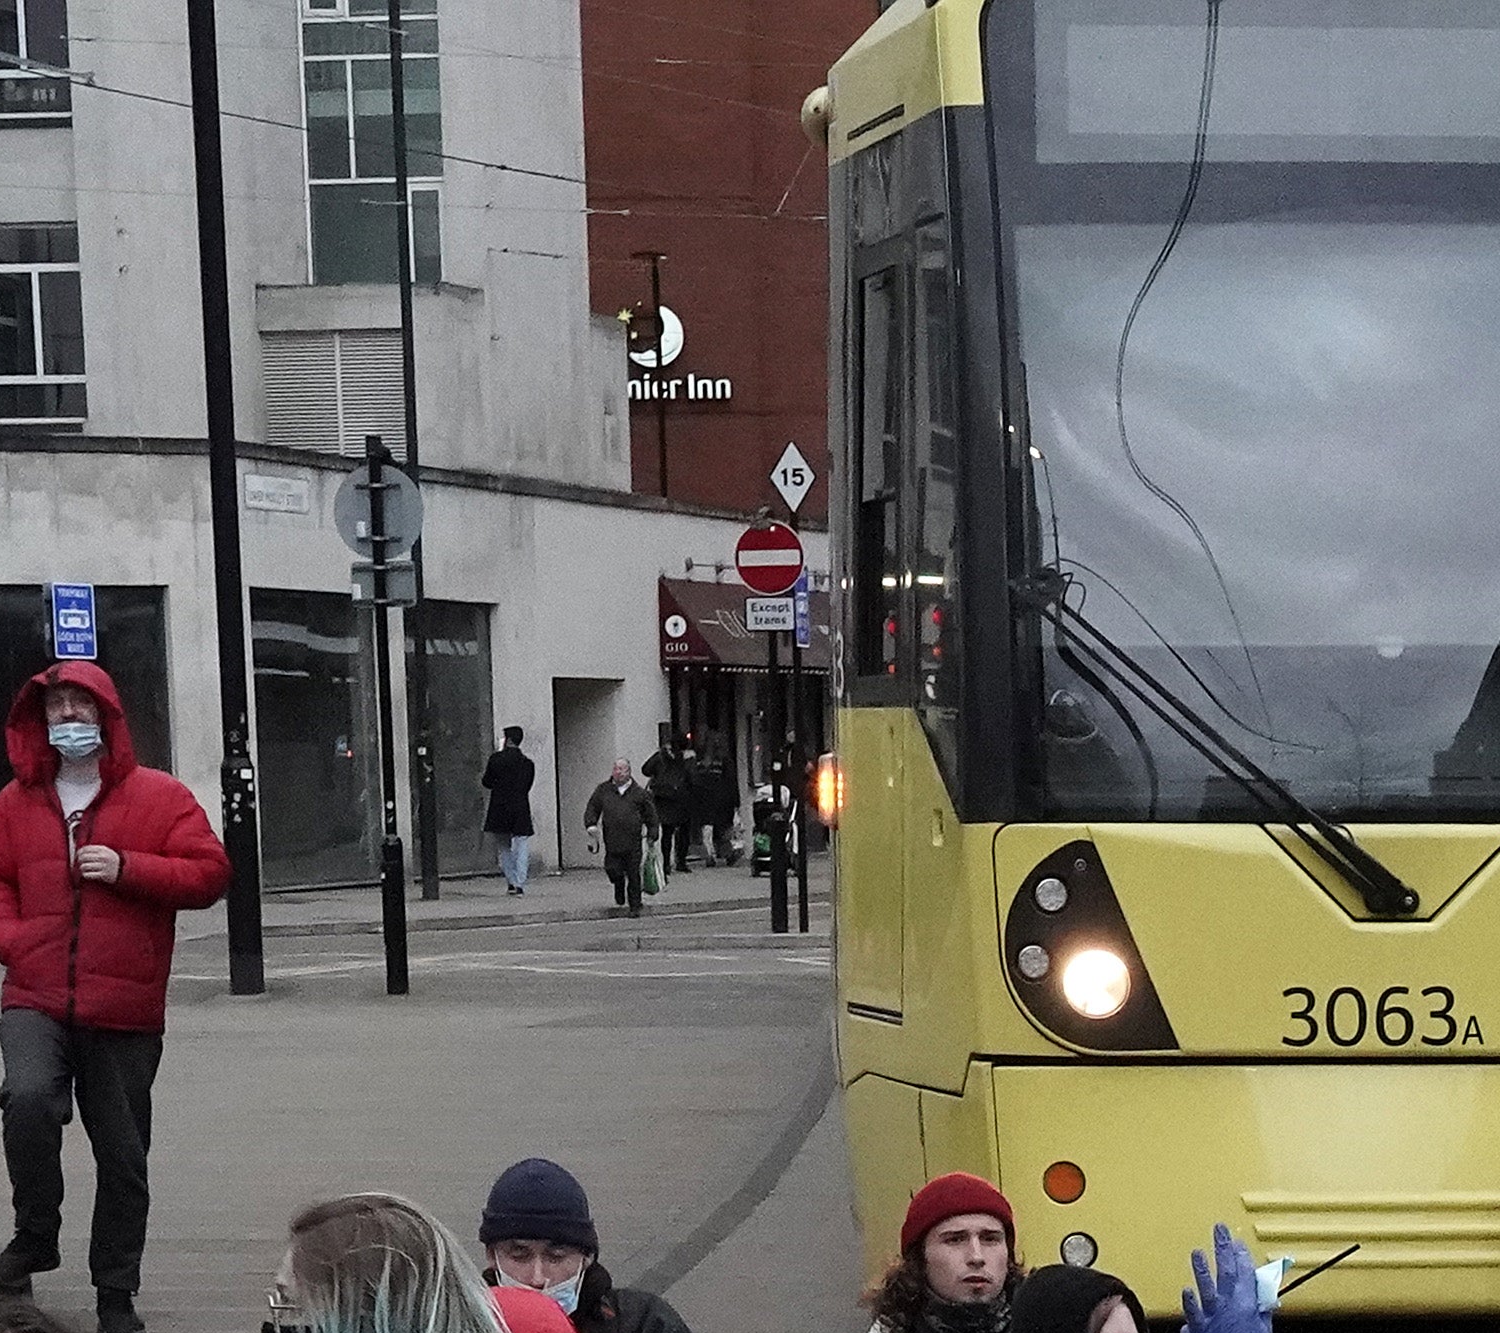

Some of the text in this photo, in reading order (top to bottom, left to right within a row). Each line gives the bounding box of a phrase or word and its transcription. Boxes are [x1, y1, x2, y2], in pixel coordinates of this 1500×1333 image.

[687, 373, 732, 400] Inn
[780, 468, 805, 487] 15
[750, 602, 792, 615] Except
[753, 614, 787, 626] trams
